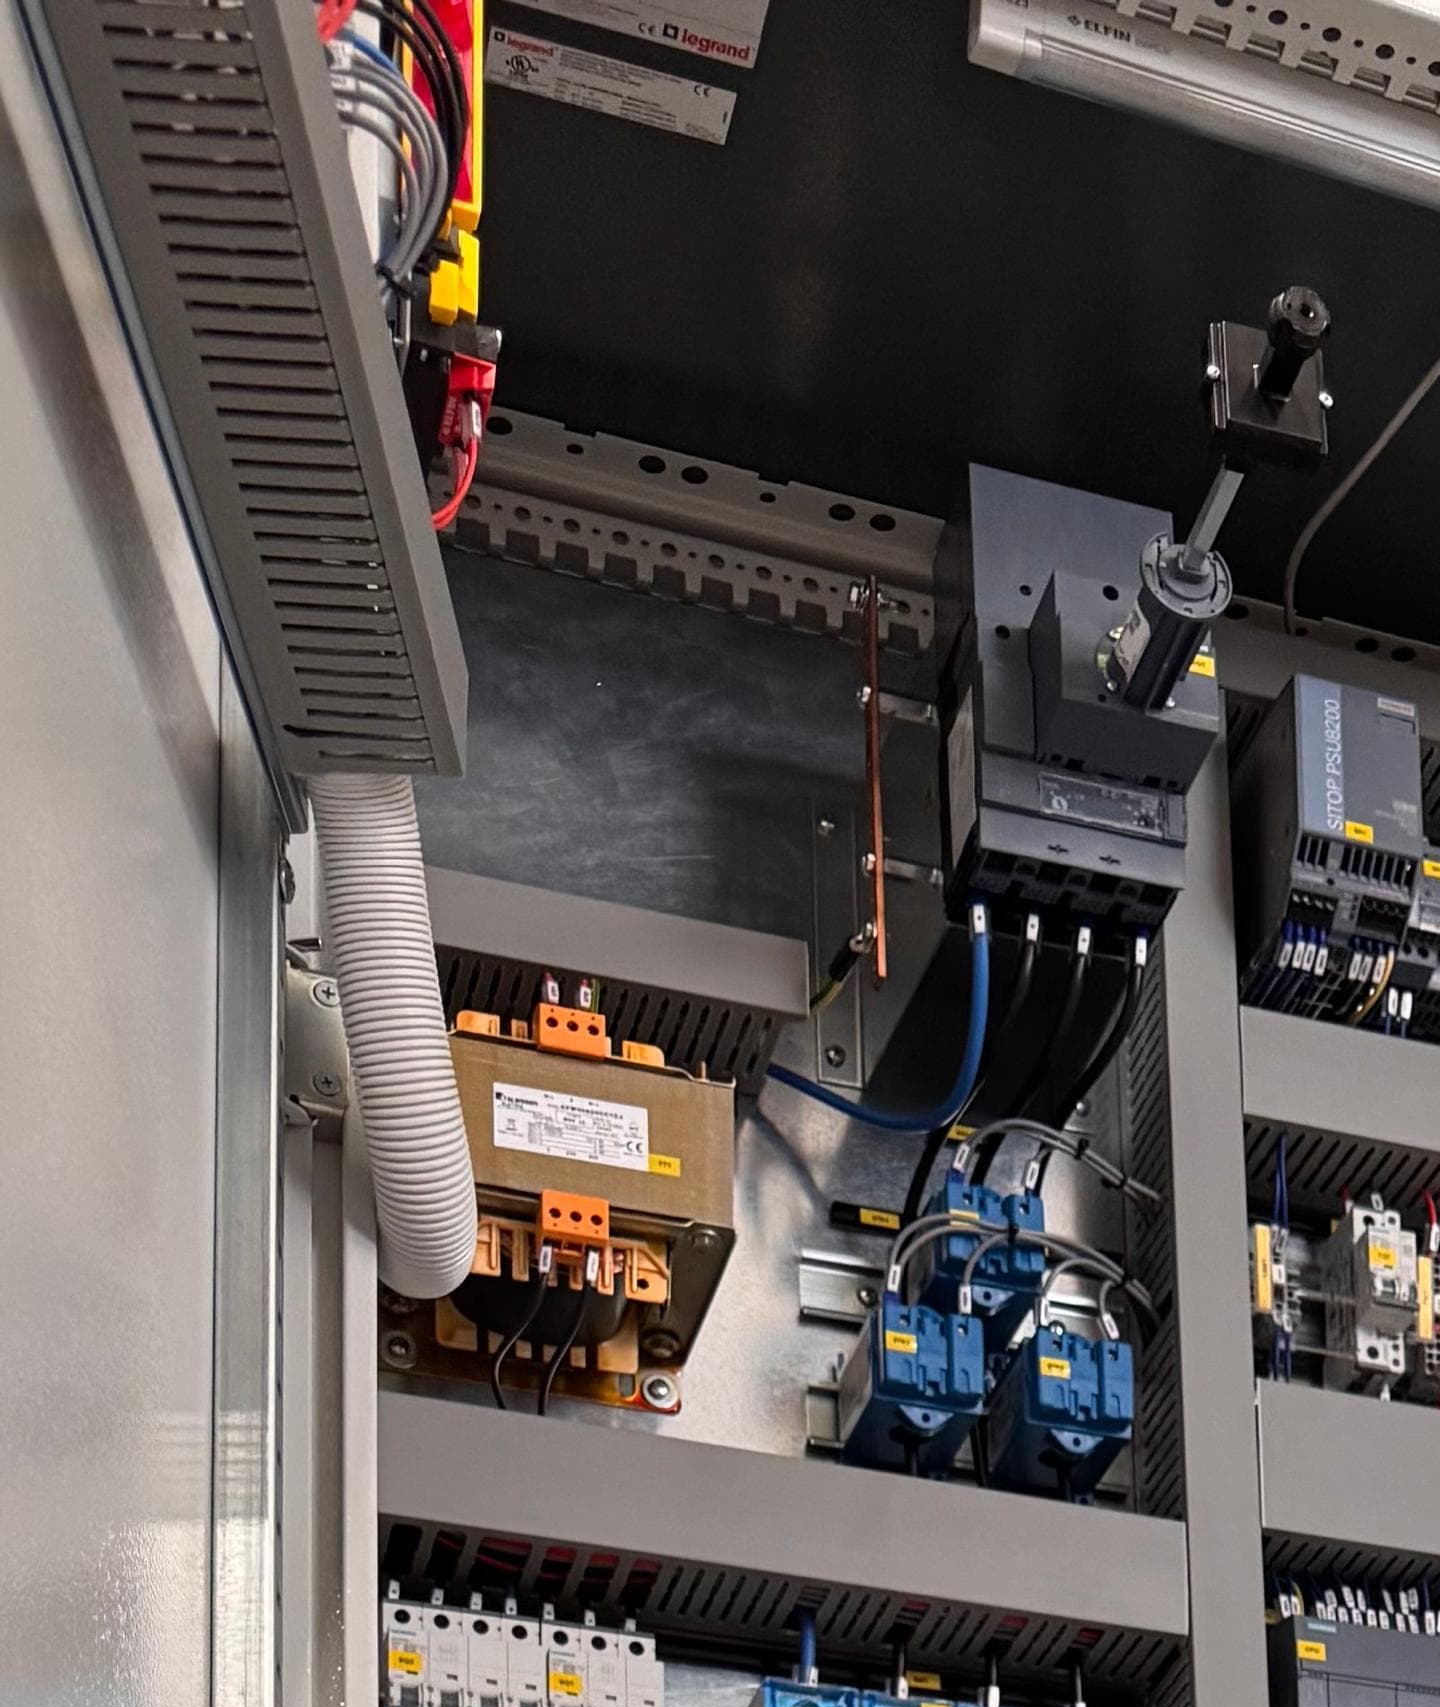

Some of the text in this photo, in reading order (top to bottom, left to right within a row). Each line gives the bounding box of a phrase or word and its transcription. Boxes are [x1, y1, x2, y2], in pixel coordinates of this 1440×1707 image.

[682, 28, 750, 61] legrand
[1084, 19, 1131, 42] ELFIN
[507, 33, 554, 57] legrand
[1324, 699, 1344, 832] SITOP PSU8200
